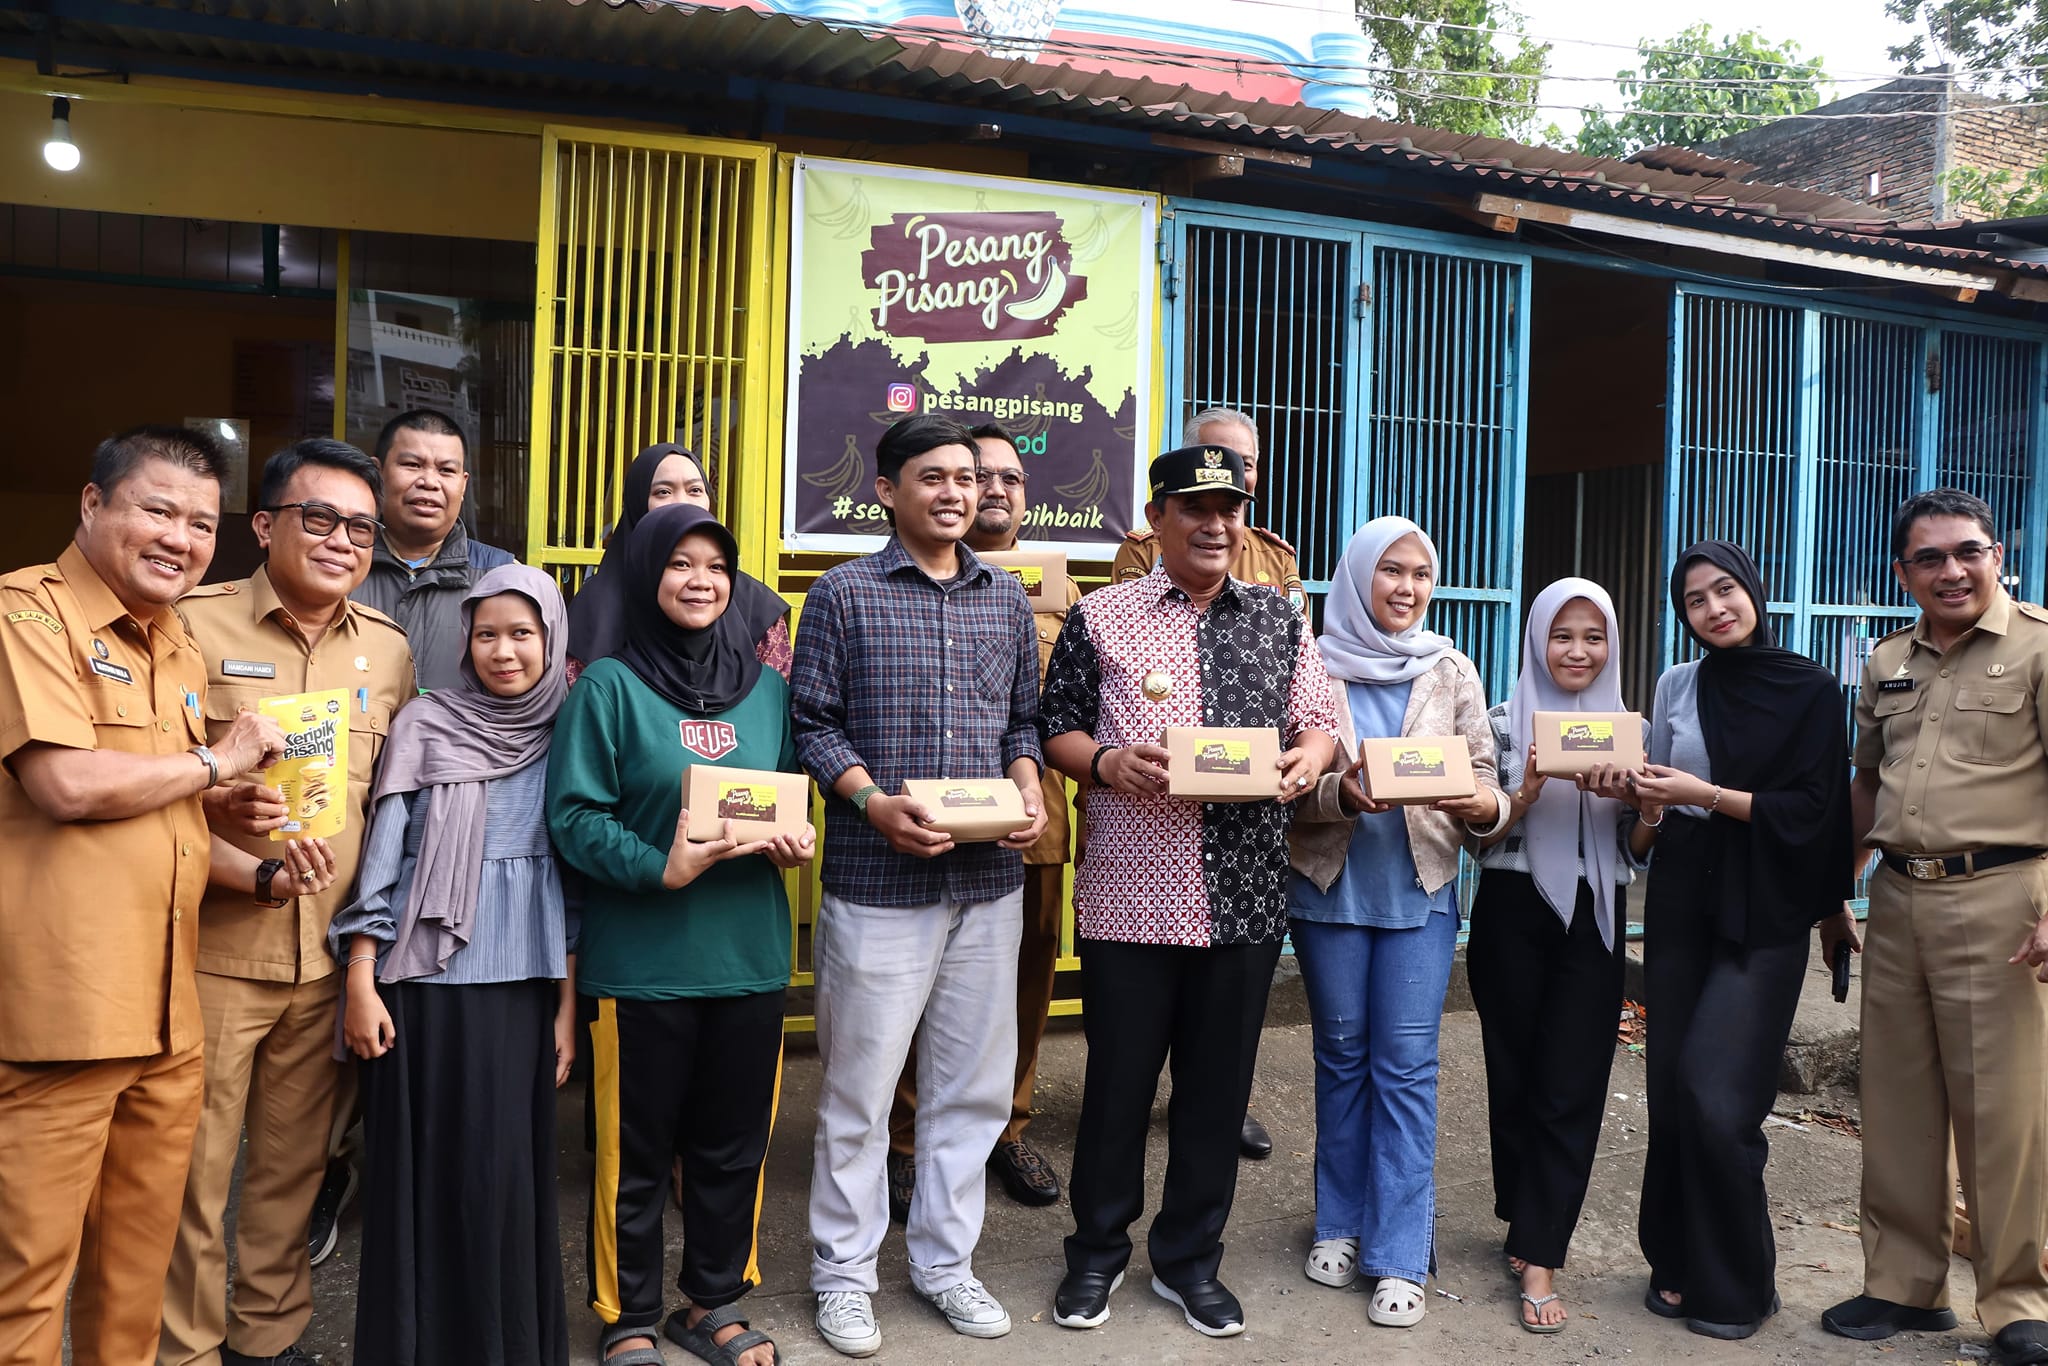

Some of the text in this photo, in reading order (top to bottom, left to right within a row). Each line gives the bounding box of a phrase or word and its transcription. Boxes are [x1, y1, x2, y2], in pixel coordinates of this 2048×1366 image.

[915, 223, 1052, 284] Pesang
[874, 269, 1009, 330] Pisang
[923, 392, 1084, 424] pesangpisang
[284, 737, 334, 759] Pisang
